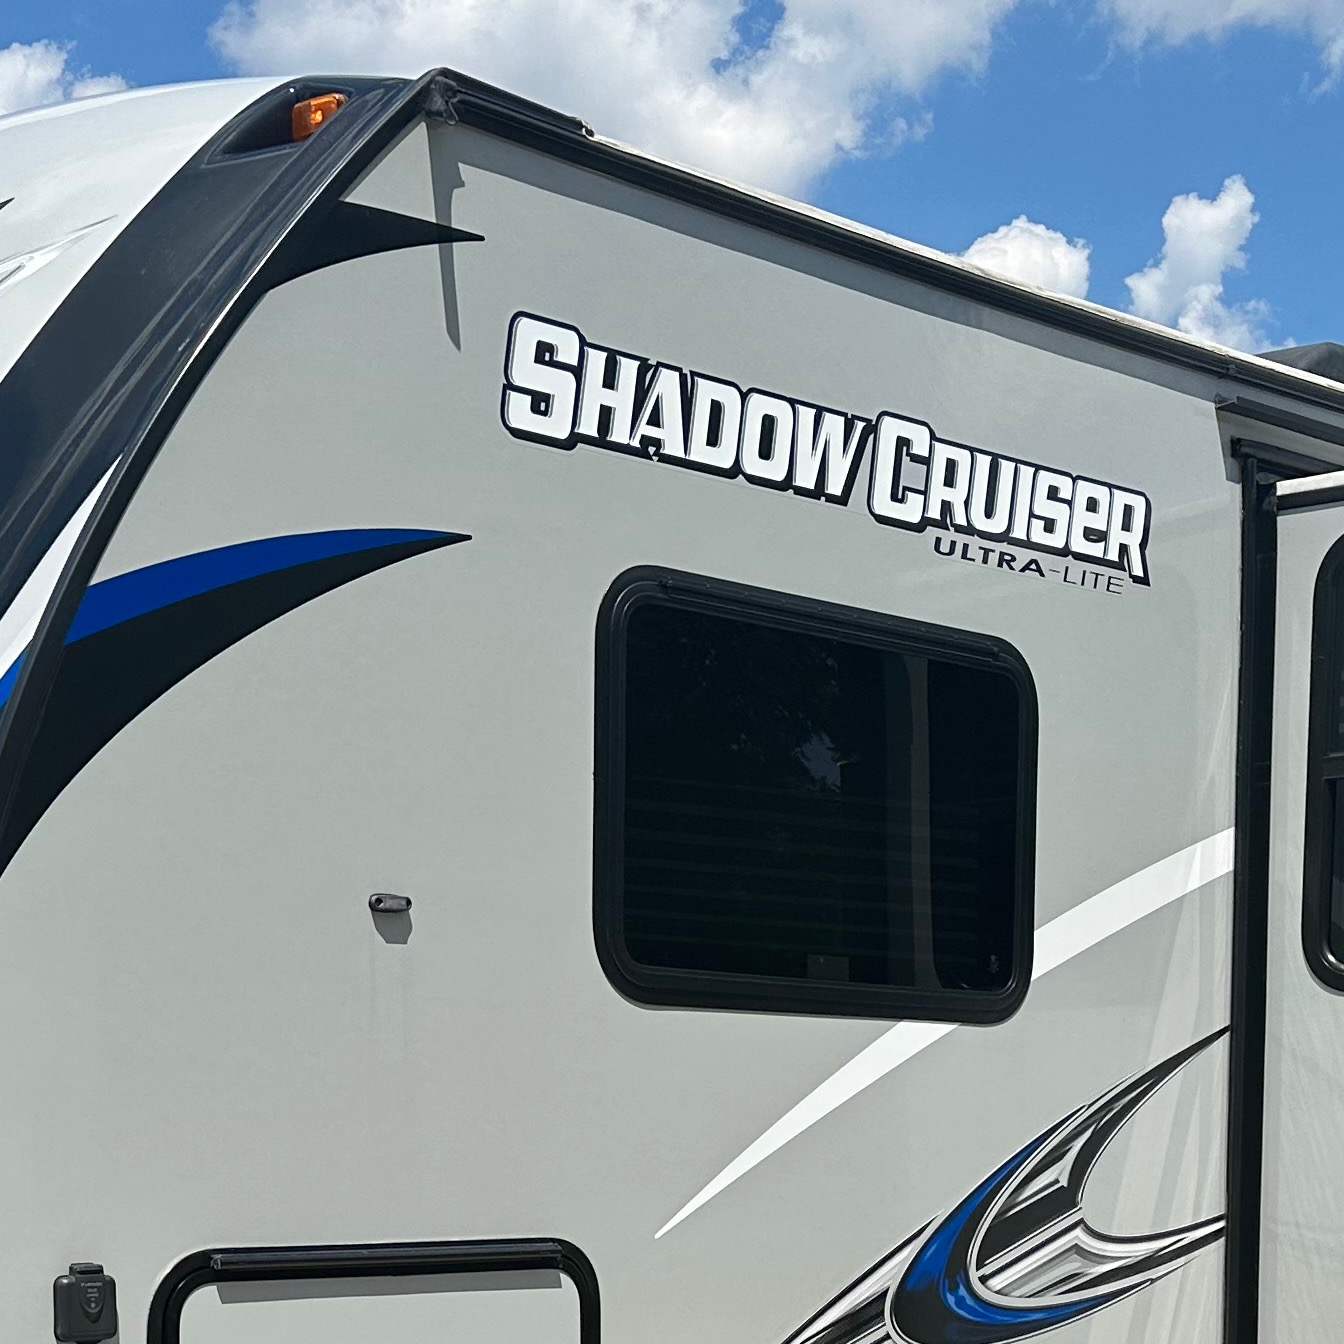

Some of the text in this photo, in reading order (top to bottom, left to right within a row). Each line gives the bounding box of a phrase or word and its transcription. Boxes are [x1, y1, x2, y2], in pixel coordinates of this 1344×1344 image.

[502, 310, 1152, 587] SHADOW CRUISER
[933, 536, 1125, 595] ULTRA-LITE
